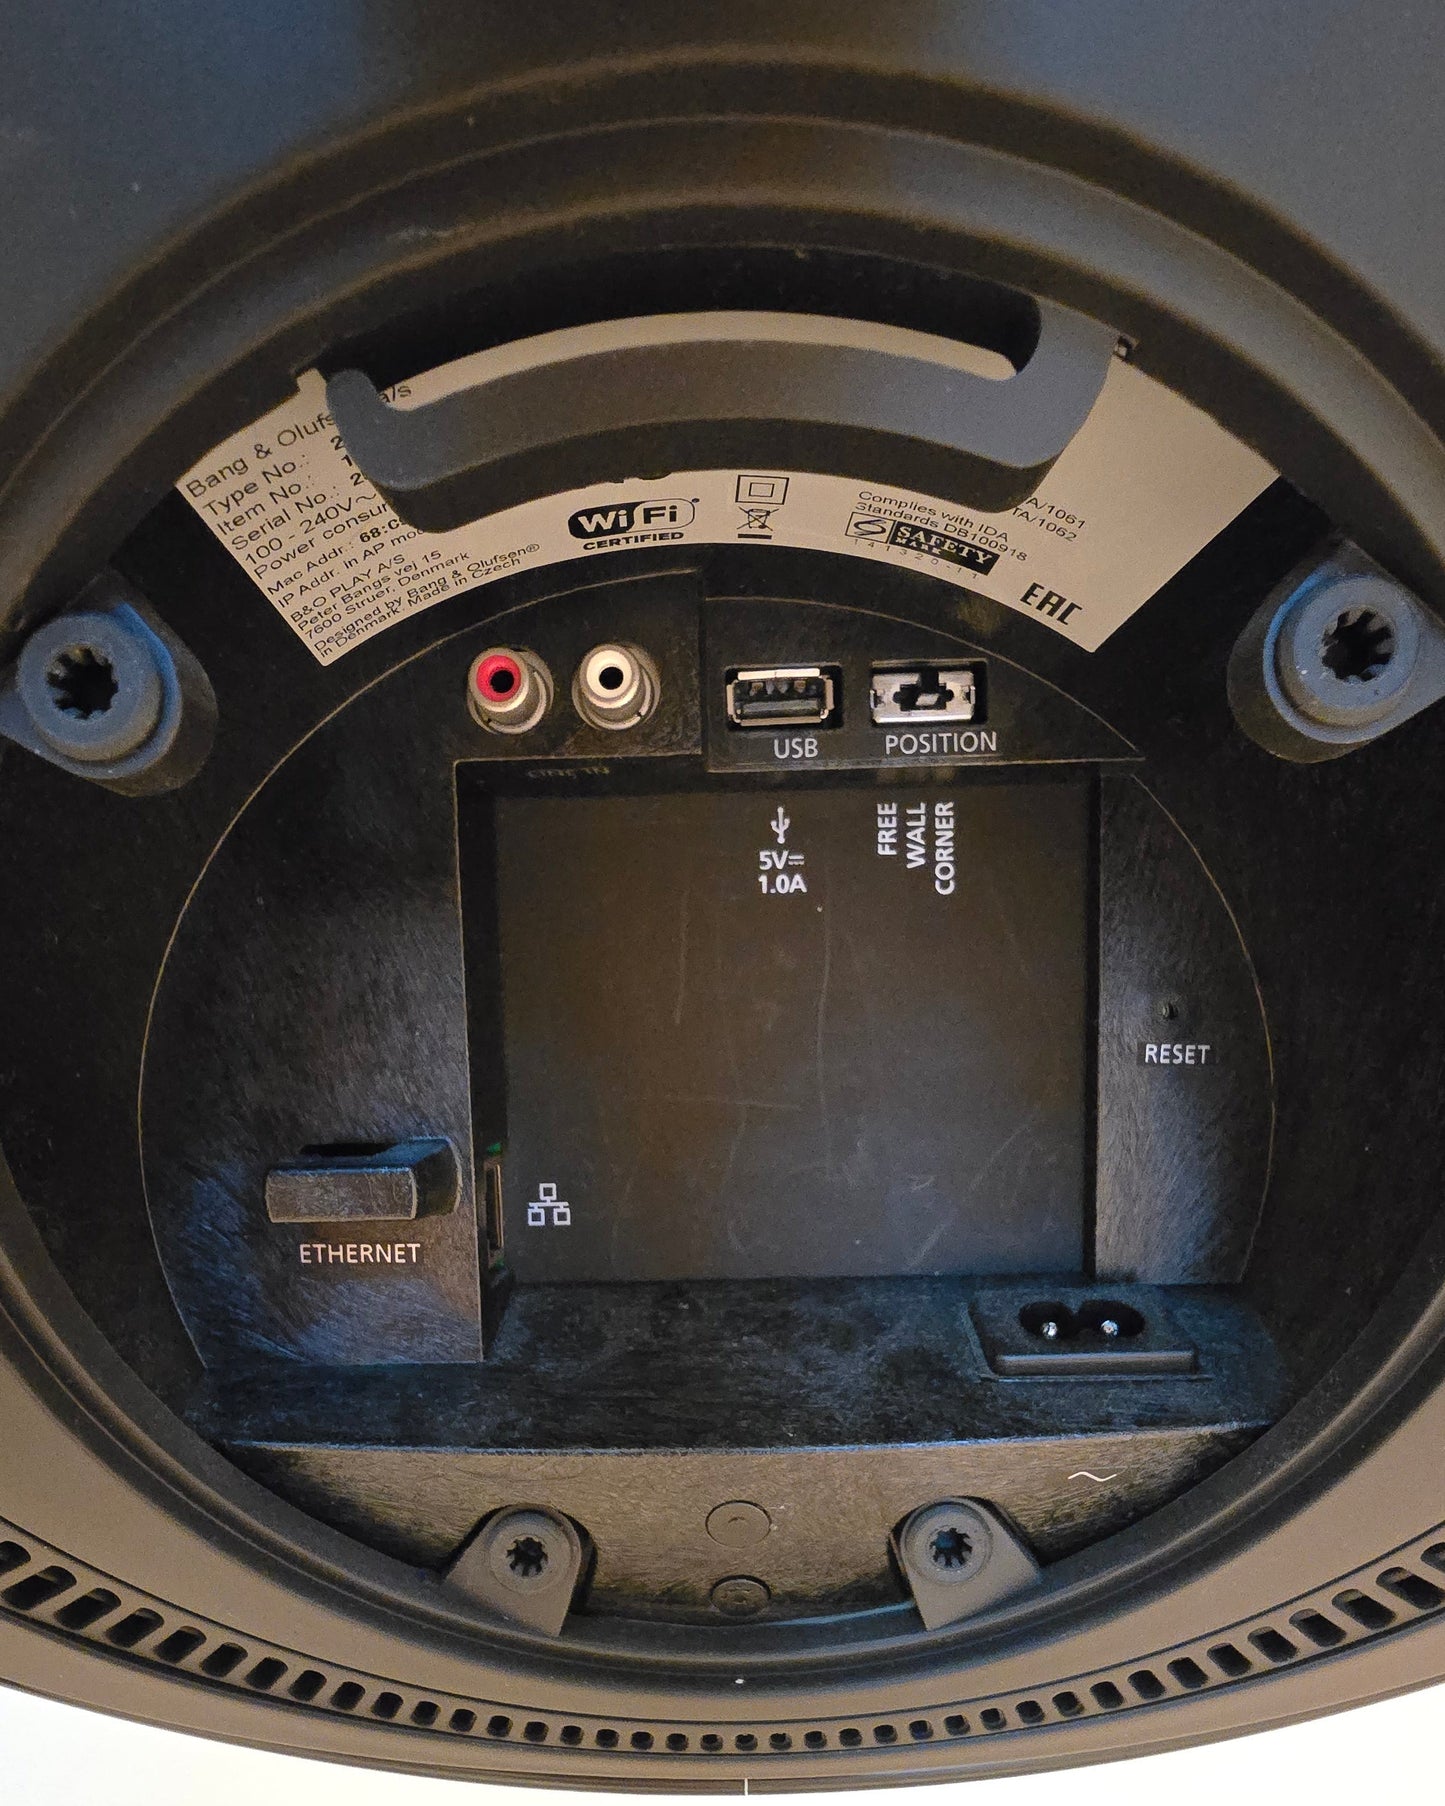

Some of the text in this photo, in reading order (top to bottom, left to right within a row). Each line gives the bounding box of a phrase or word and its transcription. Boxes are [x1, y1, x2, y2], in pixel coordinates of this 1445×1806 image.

[186, 458, 249, 498] Bang
[254, 443, 273, 461] &
[277, 413, 335, 447] Olufs
[202, 481, 259, 516] Type
[330, 435, 345, 451] 2
[217, 503, 266, 535] Item
[232, 508, 291, 550] Serial
[350, 472, 364, 487] 2
[855, 502, 1028, 561] Standards DB100918
[858, 491, 1008, 543] Complies with IDA
[1026, 497, 1086, 529] A/1061
[245, 537, 283, 565] 100
[254, 537, 315, 580] Power
[267, 570, 303, 595] Mac
[360, 518, 400, 543] 68:C
[583, 532, 684, 550] CERTIFIED
[897, 526, 993, 565] SAFETY
[278, 592, 295, 608] IP
[343, 558, 359, 570] in
[363, 542, 385, 561] AP
[290, 554, 406, 623] B&O PLAY A/S
[297, 550, 442, 631] Peter Bangs vej 15
[305, 613, 342, 639] 7600
[398, 552, 470, 587] Denmark
[314, 607, 382, 651] Designed
[384, 597, 401, 609] by
[407, 577, 447, 598] Bang
[451, 569, 462, 579] &
[320, 647, 333, 657] in
[407, 585, 450, 607] Made
[455, 577, 468, 586] in
[472, 558, 521, 579] Czech
[1020, 582, 1083, 626] EAC
[773, 738, 818, 759] USB
[885, 731, 997, 755] POSITION
[877, 802, 898, 856] FREE
[906, 801, 927, 869] WALL
[934, 801, 956, 896] CORNER
[758, 873, 808, 894] 1.0A
[1144, 1043, 1211, 1065] RESET
[299, 1242, 421, 1263] ETHERNET
